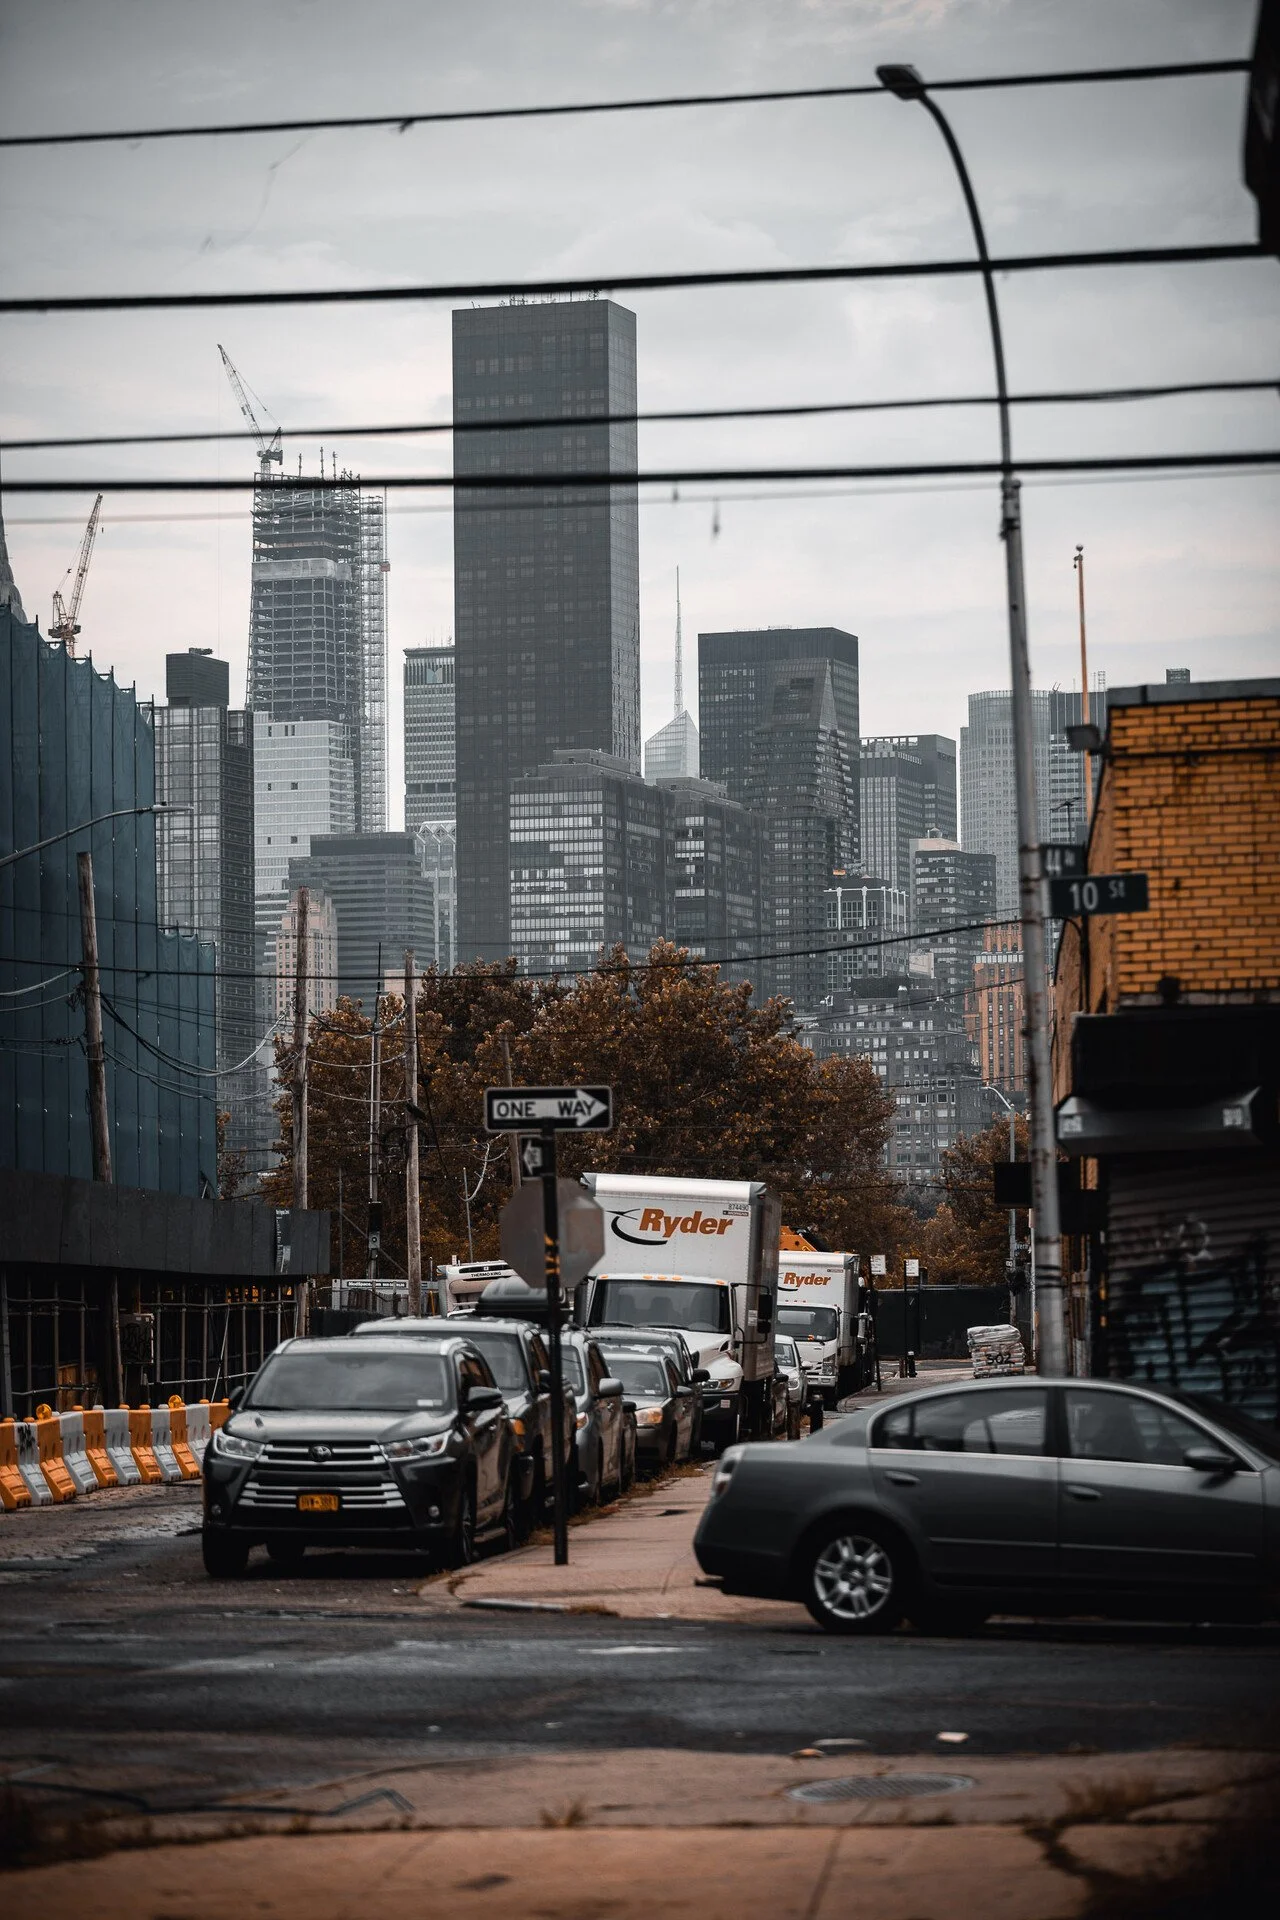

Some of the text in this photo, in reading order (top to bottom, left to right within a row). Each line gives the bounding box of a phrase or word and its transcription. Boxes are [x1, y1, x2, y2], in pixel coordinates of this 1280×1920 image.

[1045, 849, 1062, 877] 44
[1069, 880, 1125, 911] 10 St
[497, 1100, 596, 1117] ONE WAY
[639, 1208, 734, 1238] Ryder
[784, 1272, 831, 1287] Ryder
